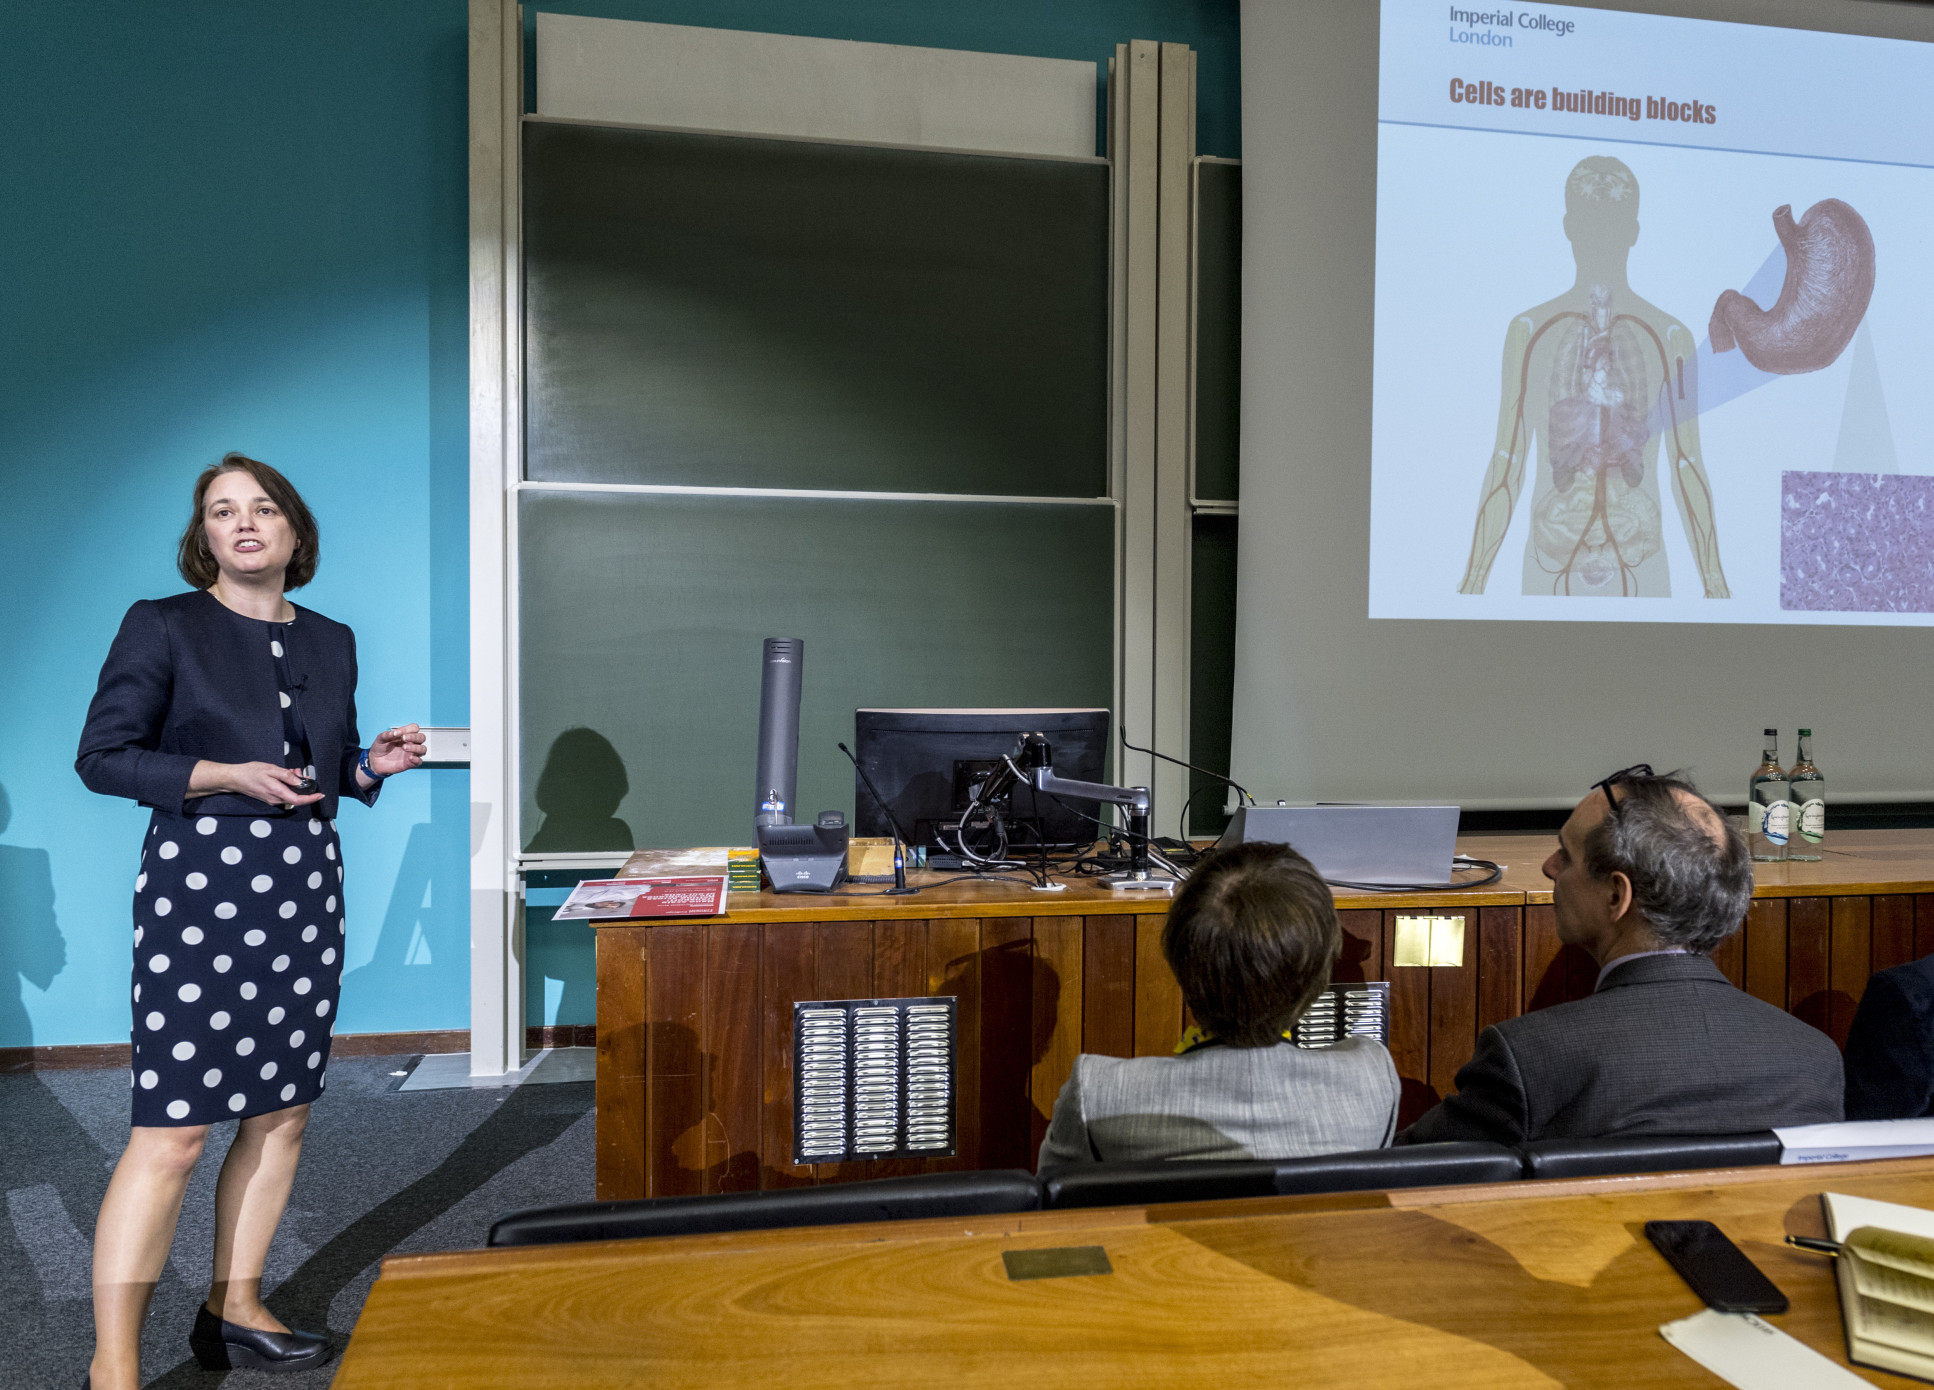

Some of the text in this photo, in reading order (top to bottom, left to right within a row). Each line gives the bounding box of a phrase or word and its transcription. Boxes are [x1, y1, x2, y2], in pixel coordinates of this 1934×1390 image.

[1449, 26, 1513, 47] London
[1450, 6, 1575, 37] Imperial College
[1449, 77, 1716, 125] Cells are building blocks
